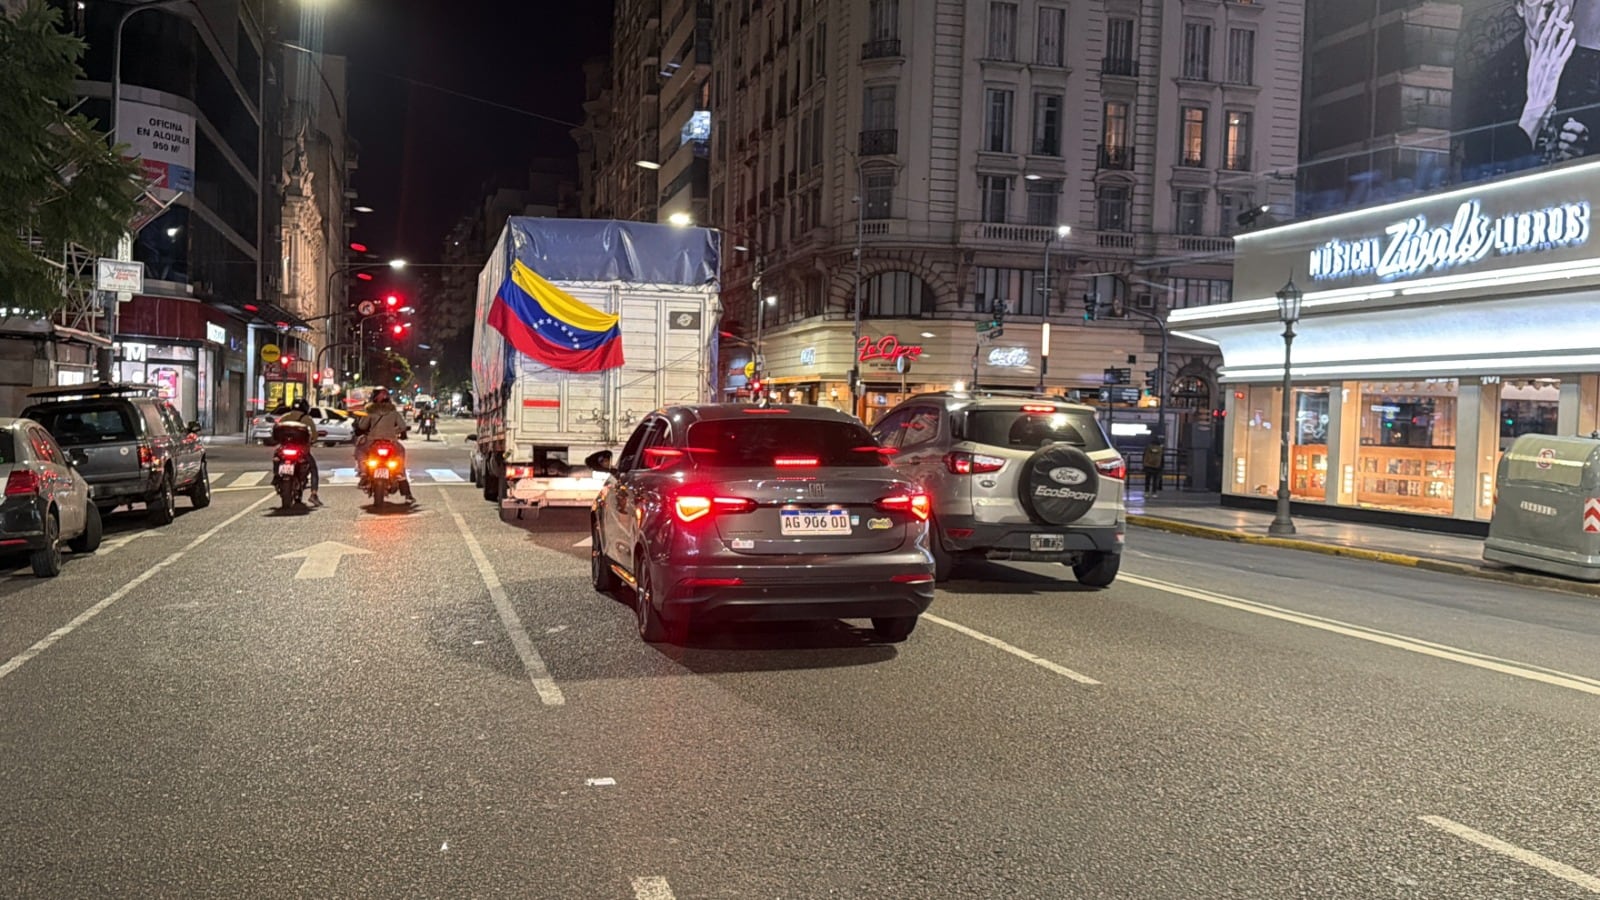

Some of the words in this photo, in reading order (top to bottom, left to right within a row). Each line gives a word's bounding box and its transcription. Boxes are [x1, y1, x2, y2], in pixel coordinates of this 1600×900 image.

[149, 118, 183, 132] OFICINA
[136, 127, 151, 137] EN
[153, 130, 190, 145] ALQUILER
[152, 141, 169, 151] 950
[1376, 200, 1495, 278] Zivals
[1495, 202, 1590, 250] LIBROS
[857, 336, 877, 361] La
[1055, 468, 1079, 482] Ford
[808, 483, 825, 497] FIAT
[785, 516, 801, 529] AG
[804, 516, 827, 529] 906
